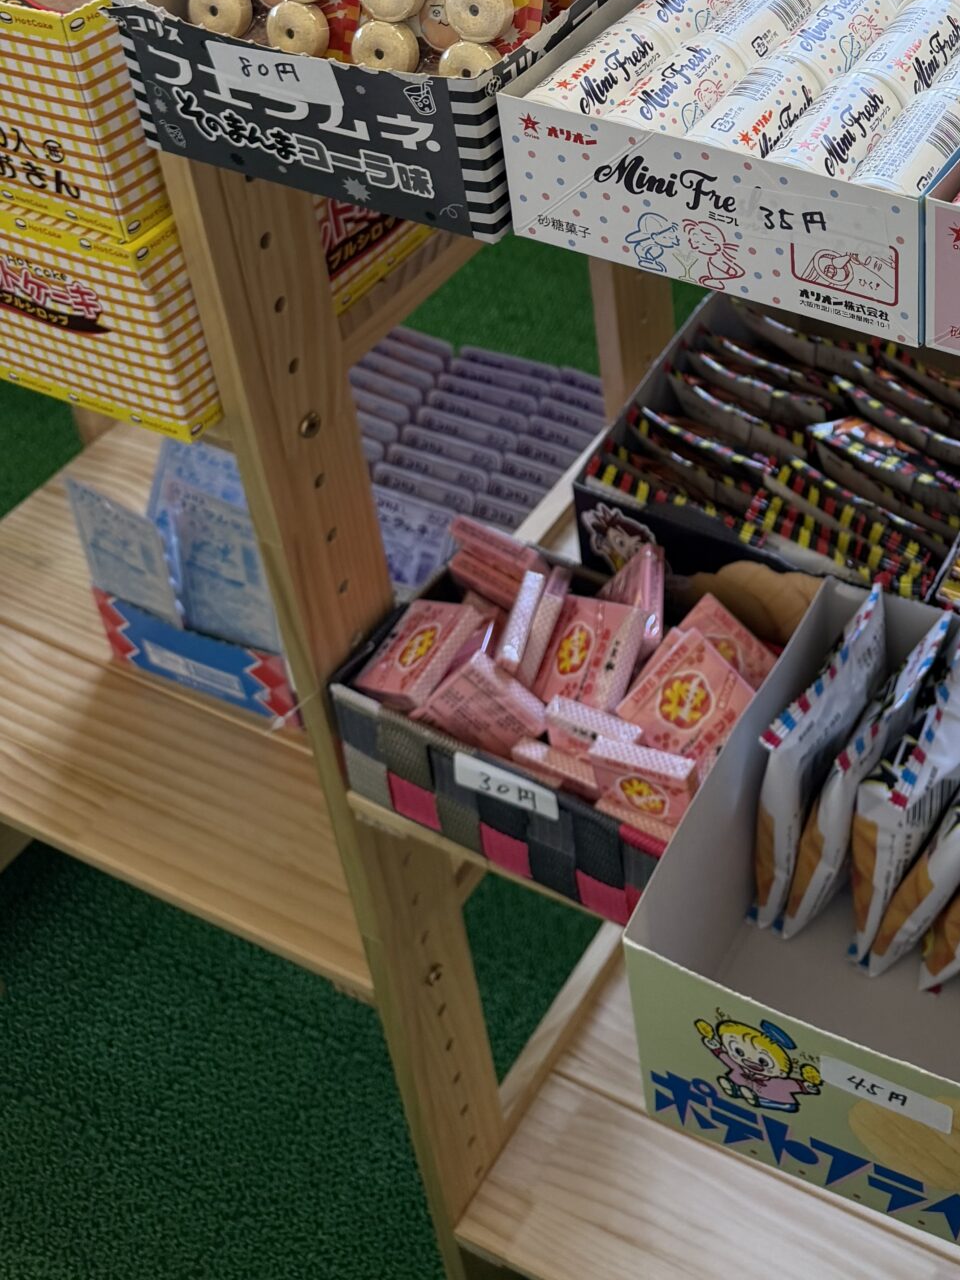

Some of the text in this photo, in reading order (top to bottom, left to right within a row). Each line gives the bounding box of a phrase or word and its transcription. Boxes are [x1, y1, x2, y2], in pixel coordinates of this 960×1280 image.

[126, 14, 184, 45] コリス
[800, 14, 834, 53] Mini
[238, 55, 301, 83] 80円
[580, 33, 655, 116] Mini Fresh
[640, 45, 713, 121] Mini Fresh
[914, 55, 943, 95] Mini
[172, 86, 436, 200] そのまんまコーラ味
[545, 124, 599, 147] オリオン
[824, 87, 886, 178] Mini Fresh
[593, 154, 756, 215] Mini Fre
[536, 213, 593, 240] 砂糖菓子
[758, 205, 828, 235] 35円
[797, 288, 891, 322] オリオン株式会社
[478, 769, 537, 811] 30円
[846, 1074, 909, 1108] 45円
